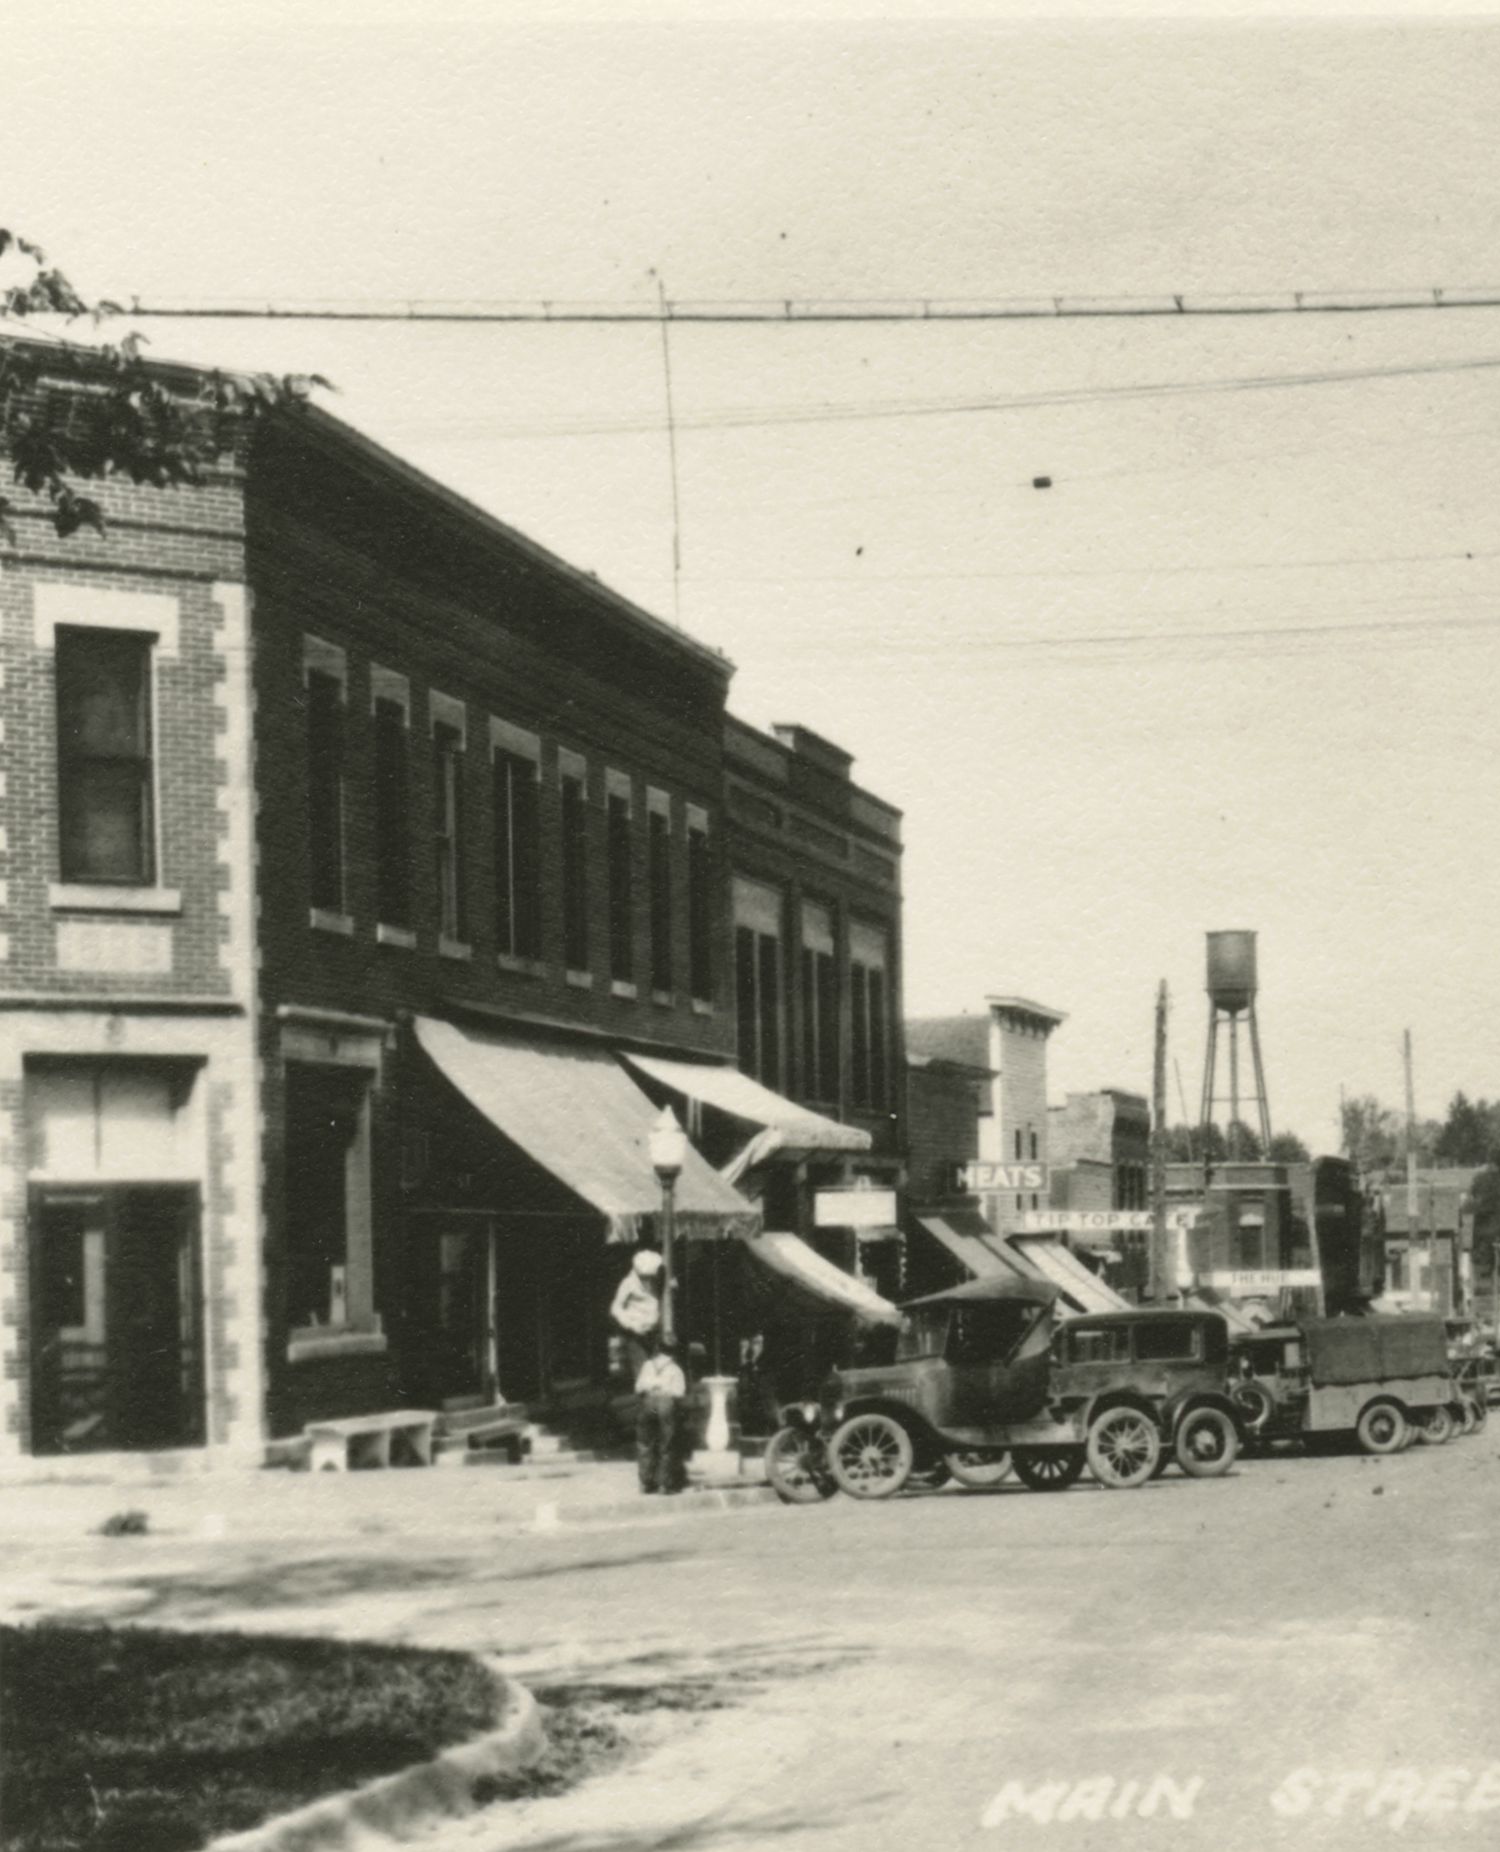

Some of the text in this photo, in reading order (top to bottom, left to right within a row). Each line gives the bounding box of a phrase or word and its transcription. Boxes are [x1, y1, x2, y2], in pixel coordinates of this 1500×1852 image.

[957, 1165, 1042, 1189] MEATS
[1036, 1213, 1189, 1227] TIP TOP CAE
